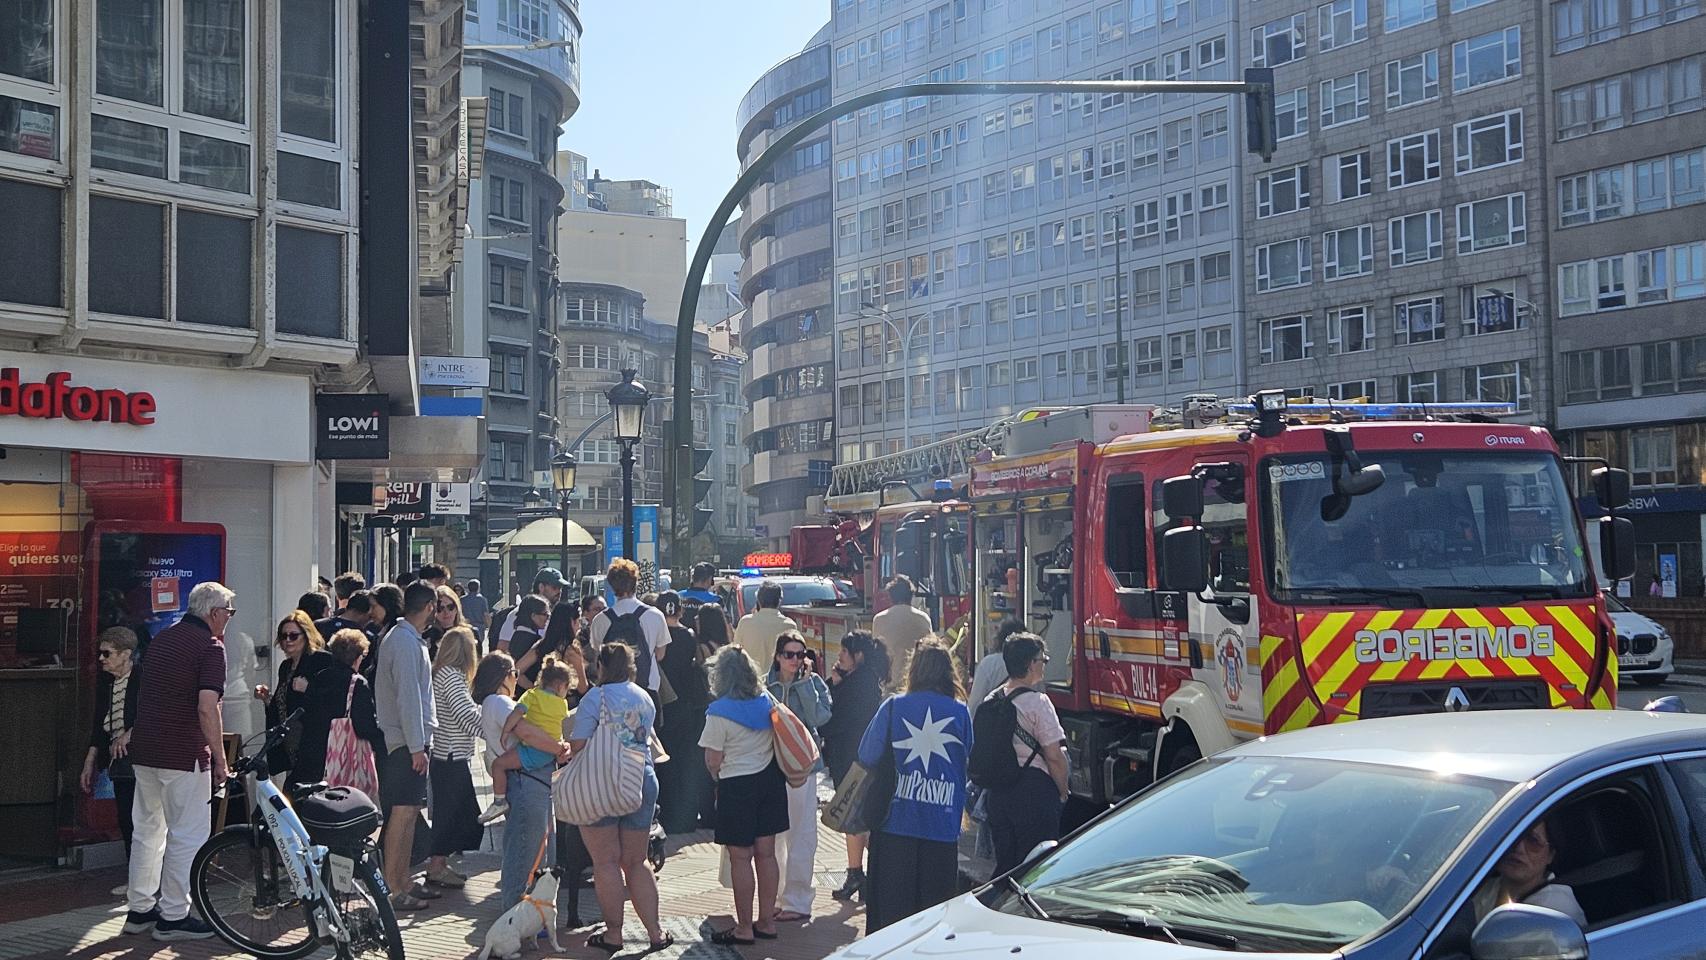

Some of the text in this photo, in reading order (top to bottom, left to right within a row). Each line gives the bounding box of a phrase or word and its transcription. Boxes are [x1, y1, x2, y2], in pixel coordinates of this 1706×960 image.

[438, 364, 464, 372] INTRE
[20, 543, 29, 552] lo
[30, 543, 47, 552] que
[8, 553, 60, 568] quieres
[745, 553, 793, 566] BOMBEROS
[1130, 663, 1159, 701] BUL-14
[267, 813, 279, 829] 092
